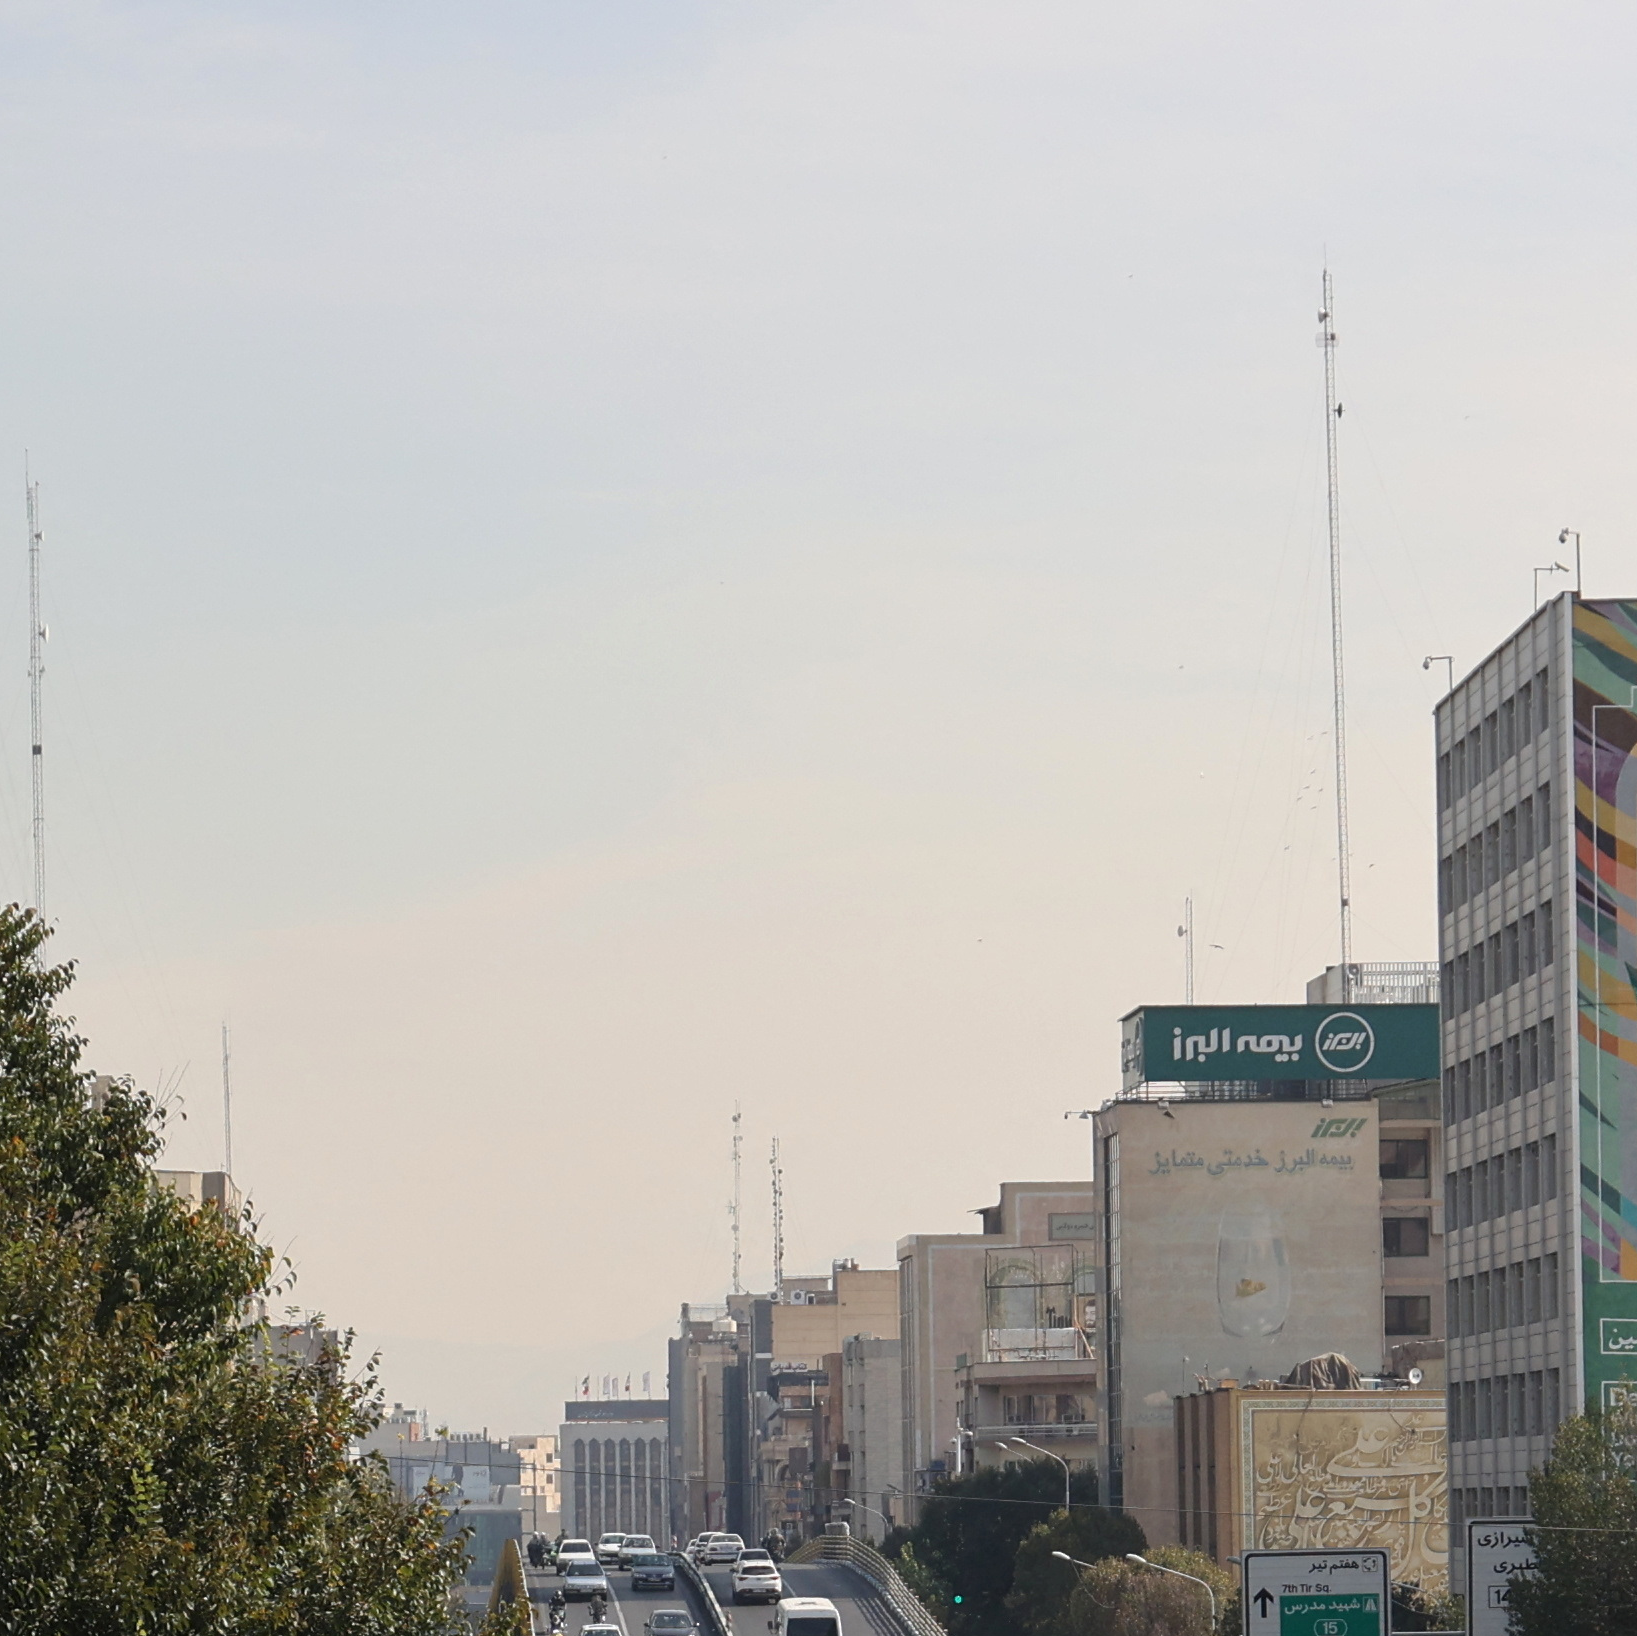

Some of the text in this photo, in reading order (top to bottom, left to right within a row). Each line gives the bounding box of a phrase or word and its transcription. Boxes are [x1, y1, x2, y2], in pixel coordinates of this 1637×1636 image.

[1173, 1026, 1231, 1063] البرز
[1237, 1033, 1303, 1063] بیمه
[1148, 1147, 1355, 1176] بیمه البرز خدمتی متمایز
[1308, 1558, 1360, 1575] هفتم تیر
[1281, 1583, 1332, 1595] 7th Tir Sq.
[1284, 1599, 1361, 1615] شهید مدرس
[1322, 1621, 1338, 1635] 15
